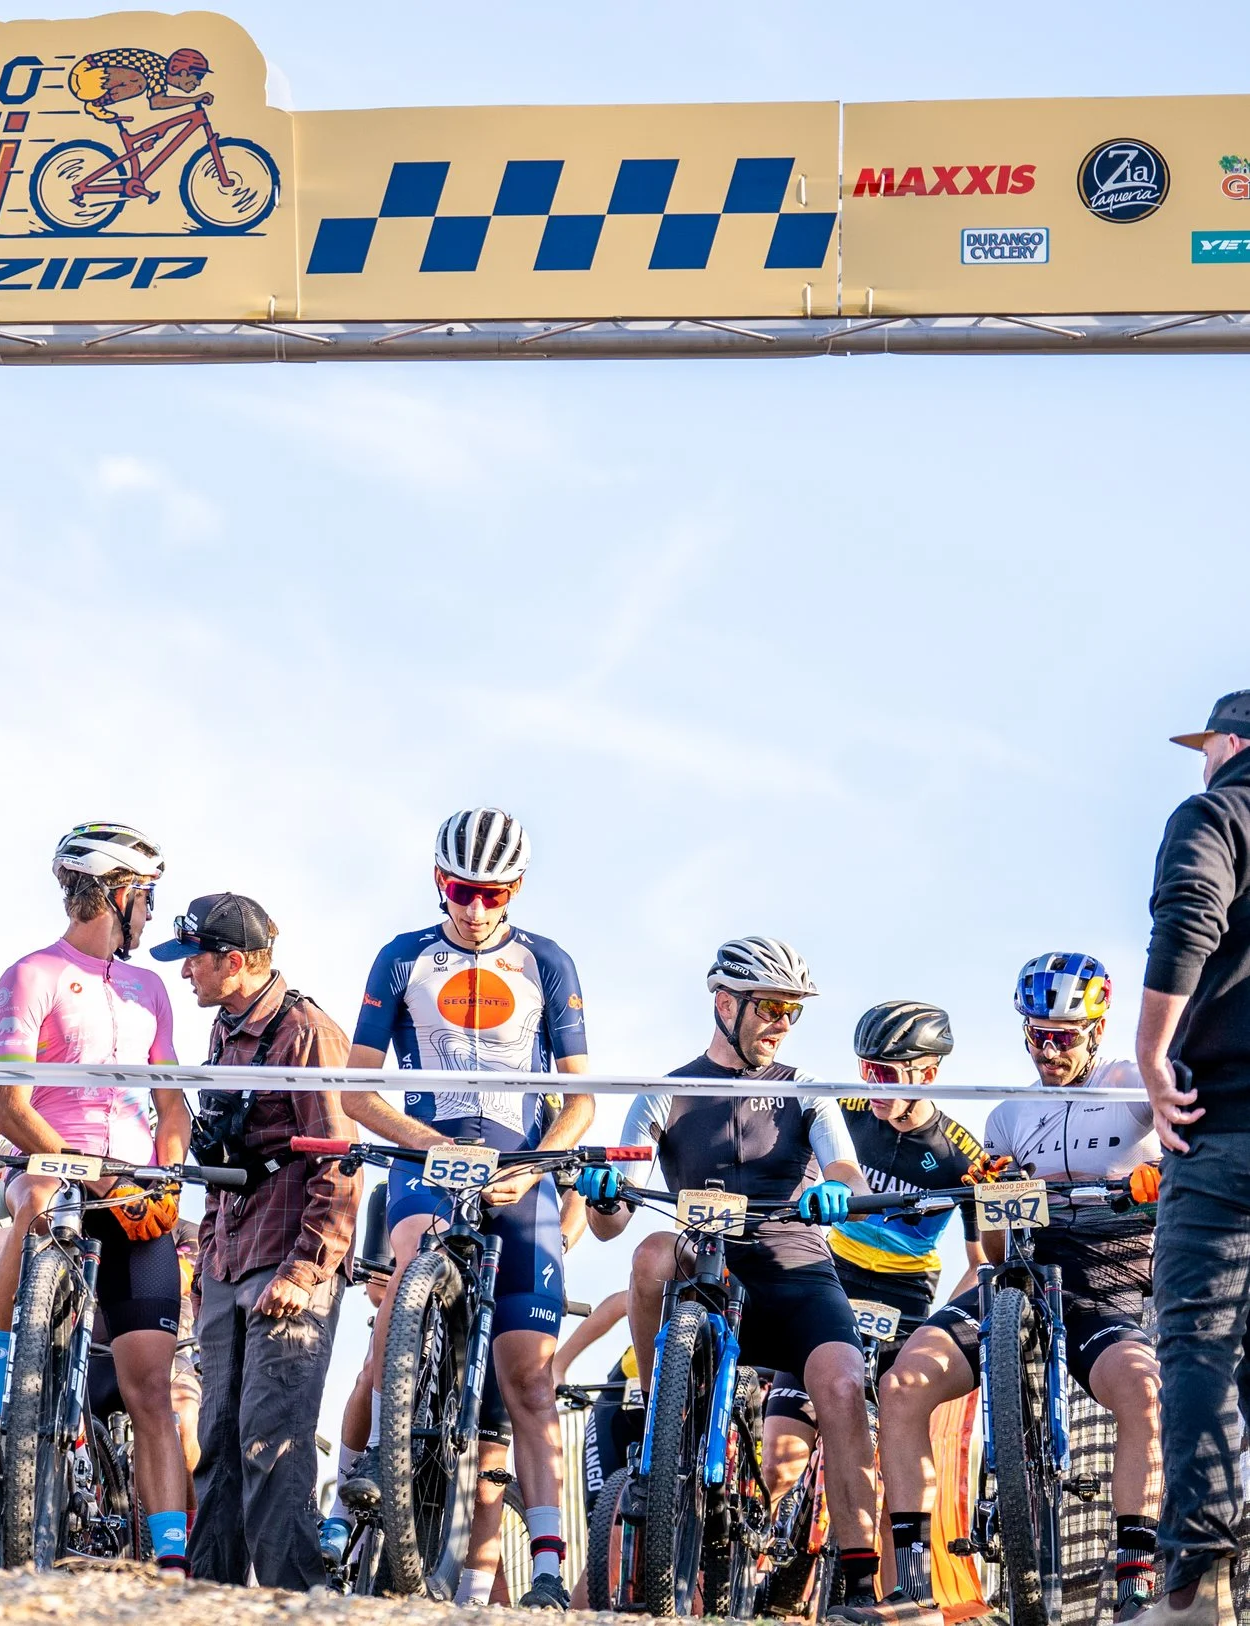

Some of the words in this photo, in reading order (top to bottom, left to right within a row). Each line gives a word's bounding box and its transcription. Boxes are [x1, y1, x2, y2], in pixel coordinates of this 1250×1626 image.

[1103, 149, 1149, 189] Zia
[852, 164, 1036, 197] MAXXIS
[1089, 188, 1161, 214] taqueria
[966, 232, 1044, 247] DURANGO
[970, 245, 1039, 260] CYCLERY
[729, 963, 750, 976] GIRO
[443, 998, 500, 1006] SEGMENT
[750, 1096, 784, 1111] CAPO
[41, 1161, 88, 1176] 515
[430, 1159, 490, 1185] 523
[982, 1183, 1014, 1192] DURANGO
[1015, 1181, 1039, 1189] DERBY
[719, 1193, 741, 1201] DERBY
[688, 1205, 734, 1227] 514
[984, 1197, 1040, 1223] 507
[529, 1306, 556, 1323] JINGA
[853, 1309, 892, 1335] 28
[767, 1387, 810, 1401] ZIP
[478, 1429, 498, 1437] KROO
